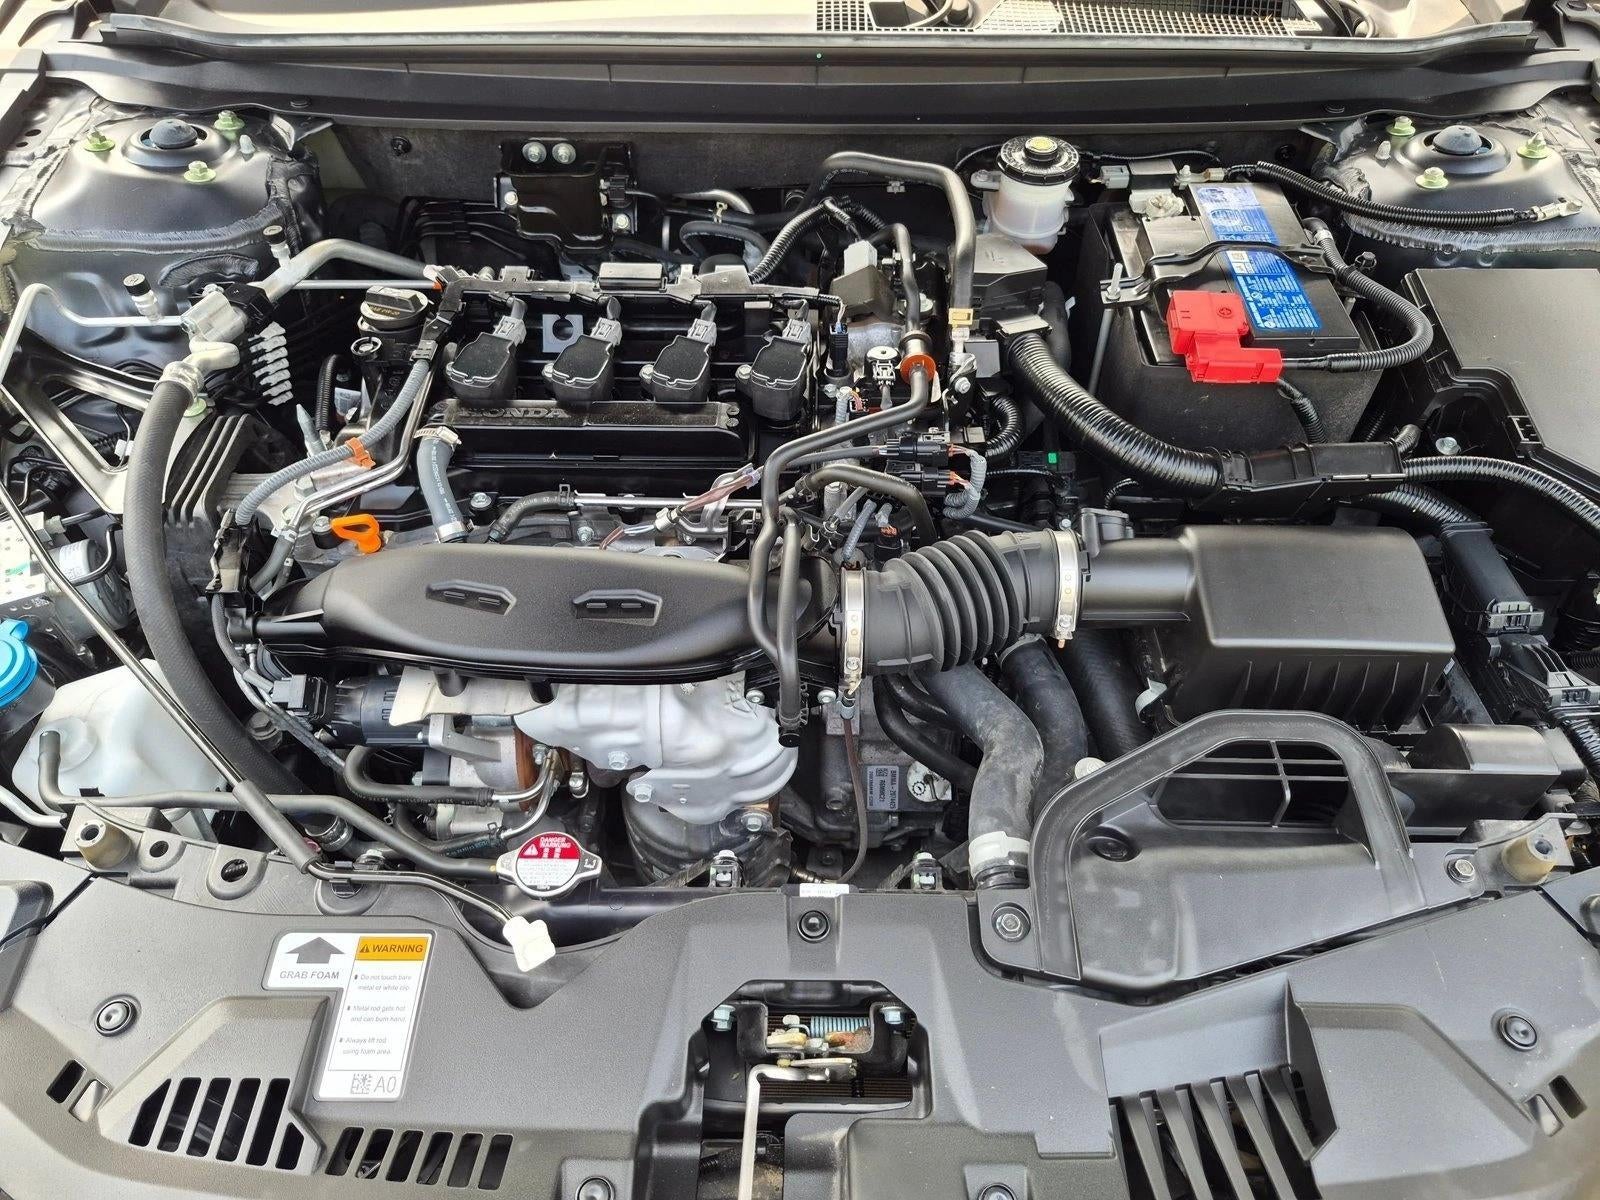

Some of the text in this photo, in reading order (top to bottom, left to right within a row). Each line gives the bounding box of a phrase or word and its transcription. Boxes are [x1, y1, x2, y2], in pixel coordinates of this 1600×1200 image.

[459, 407, 571, 418] HONDA
[372, 944, 423, 953] WARNING
[279, 970, 340, 980] GRAB FOAM
[345, 1037, 366, 1045] Always
[373, 1075, 397, 1093] A0
